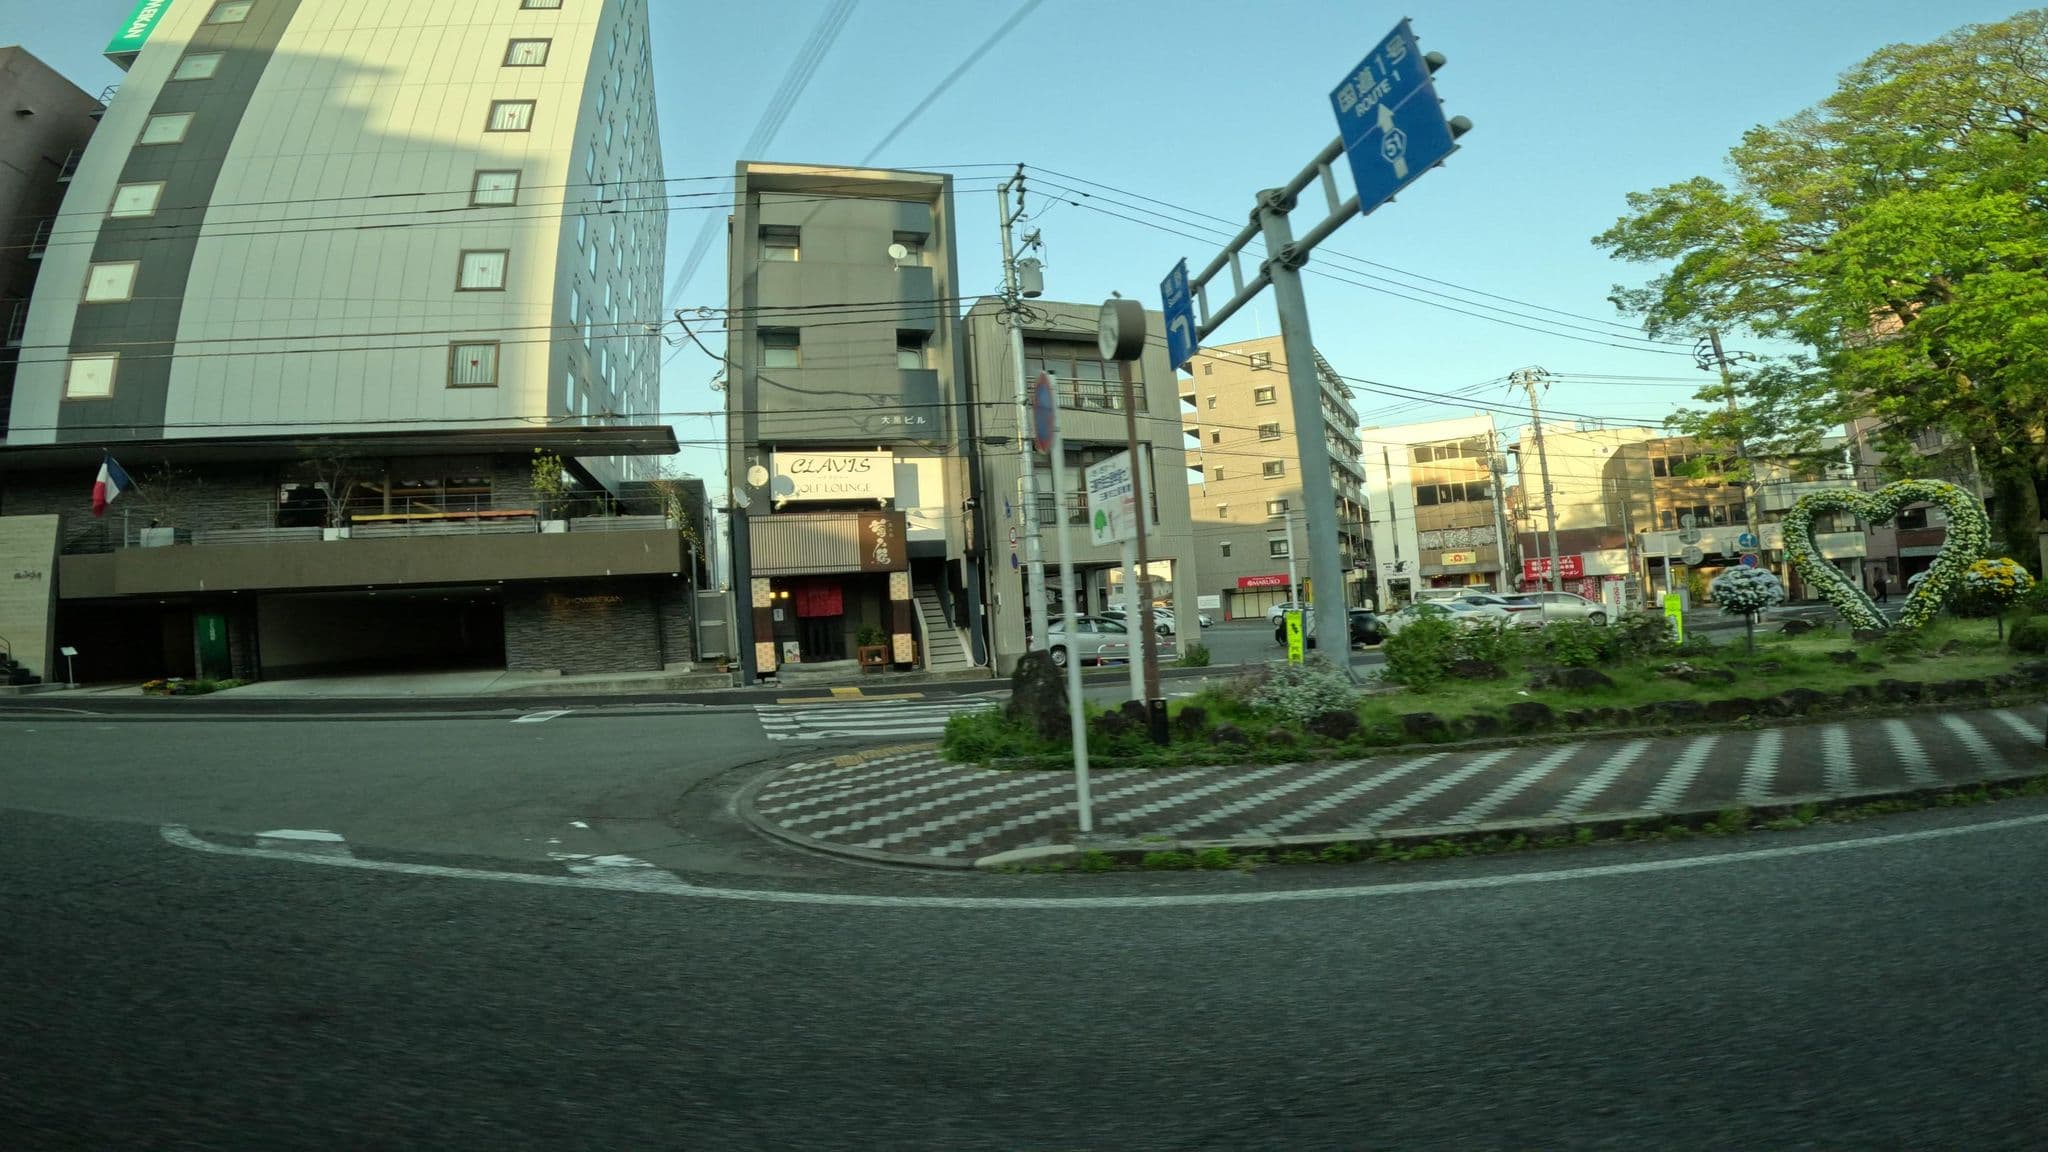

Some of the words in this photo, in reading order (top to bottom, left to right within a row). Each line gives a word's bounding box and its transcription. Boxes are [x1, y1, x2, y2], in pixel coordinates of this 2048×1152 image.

[1355, 78, 1392, 117] ROUTE
[1391, 69, 1400, 81] 1
[1385, 132, 1403, 156] 51
[790, 458, 871, 473] CLAVIS
[824, 483, 871, 493] LOUNGE
